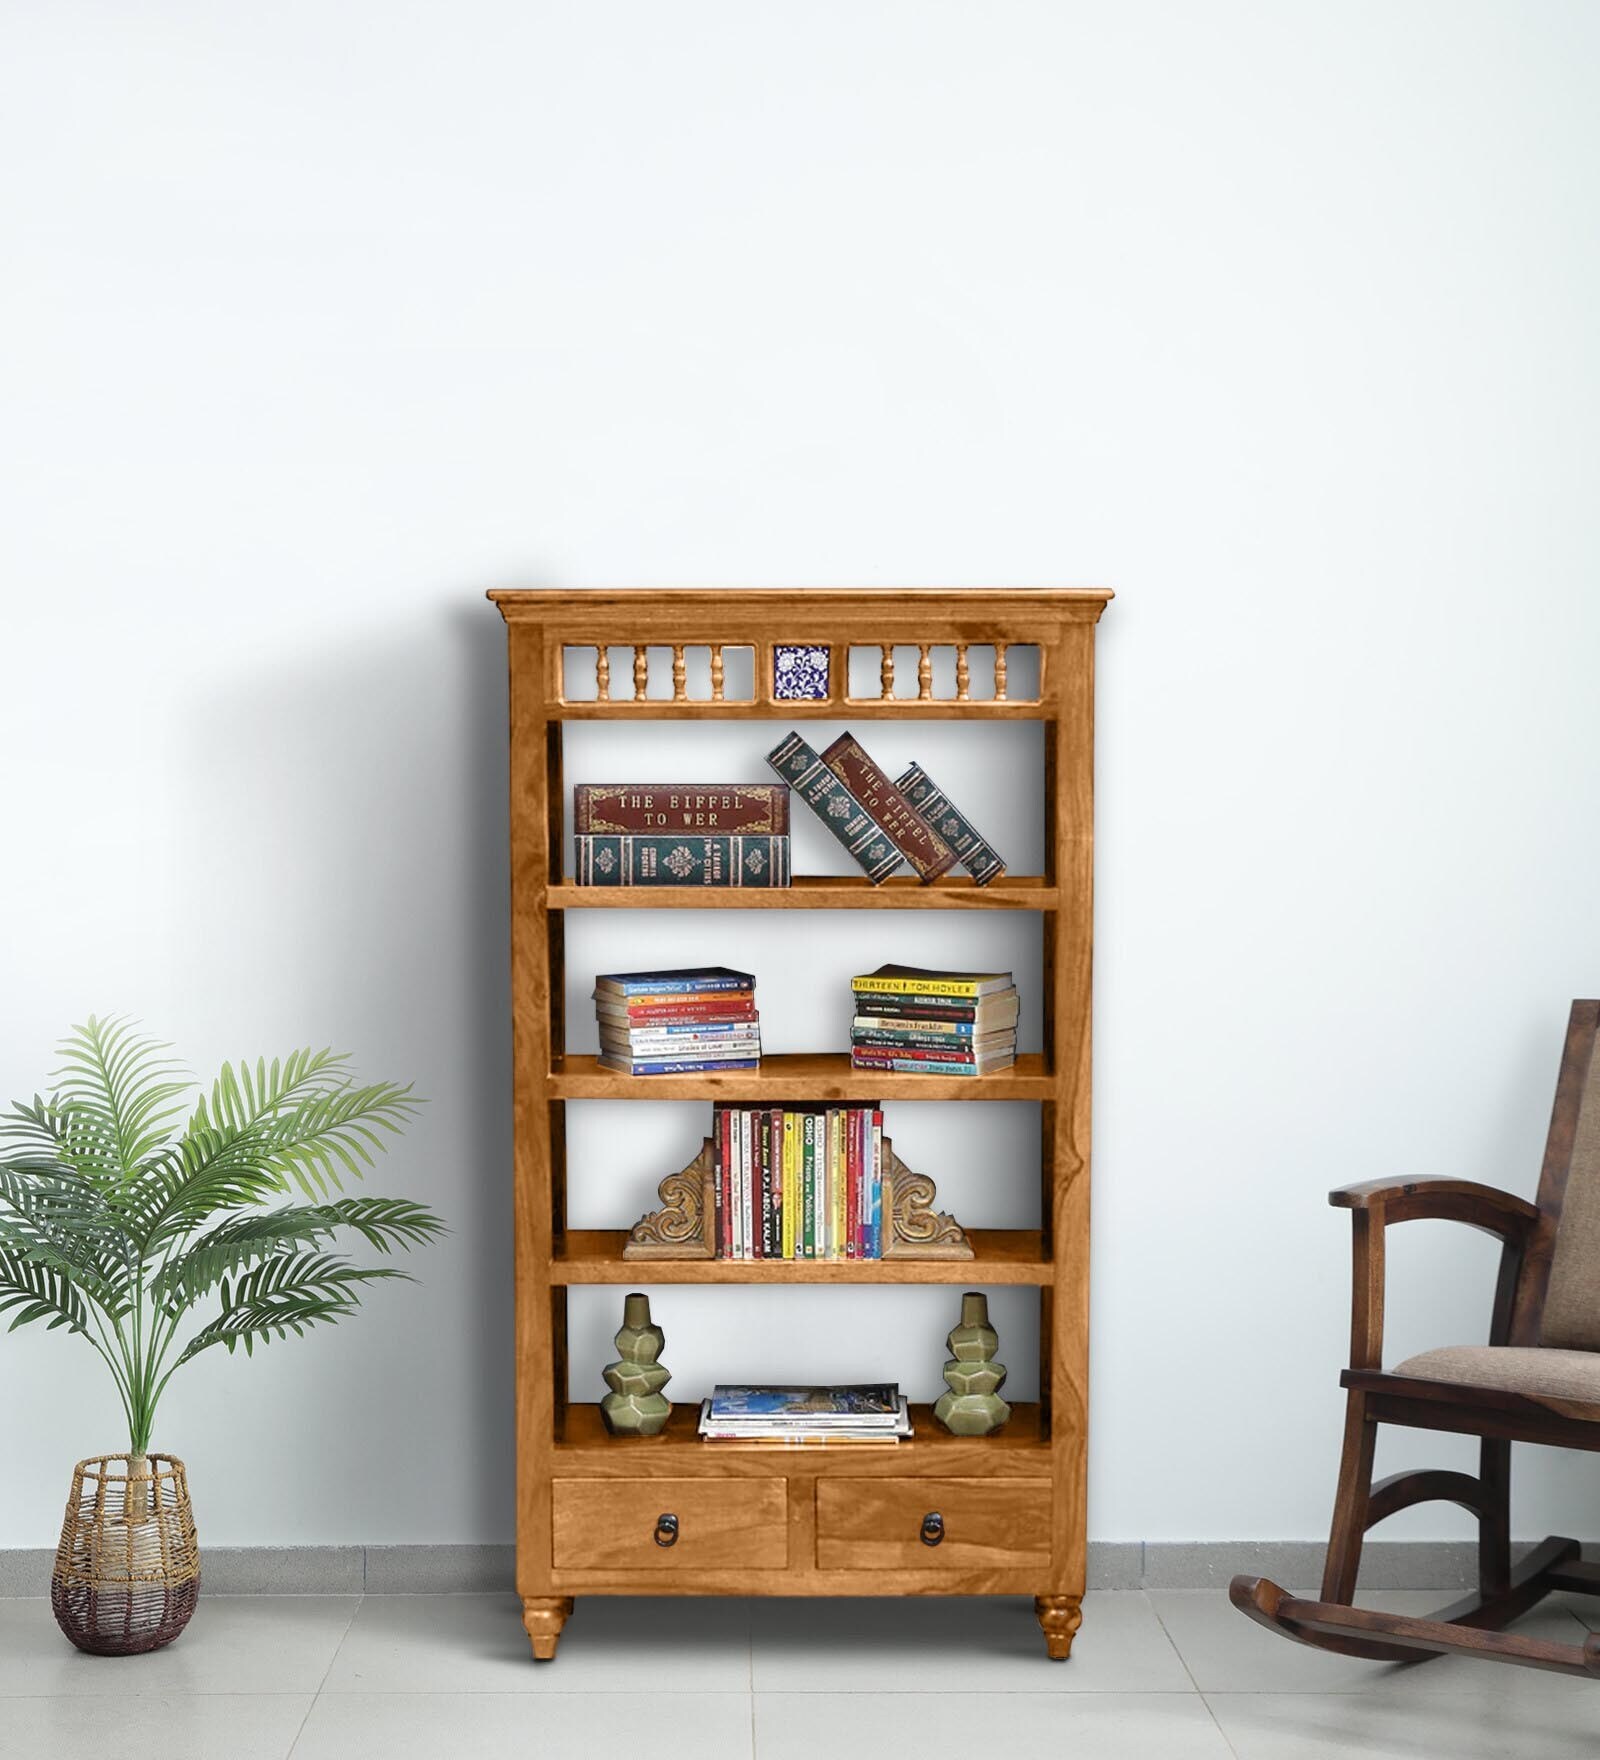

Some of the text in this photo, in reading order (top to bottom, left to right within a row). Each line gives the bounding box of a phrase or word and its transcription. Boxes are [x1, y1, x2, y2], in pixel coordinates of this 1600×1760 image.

[619, 795, 744, 810] THE EIFFEL
[859, 765, 928, 845] THE EIFFEL
[862, 789, 905, 841] TO WER
[644, 812, 719, 827] TO WER
[853, 979, 899, 990] THIRTEEN
[804, 1118, 813, 1145] OSHO
[762, 1223, 771, 1253] KALAM
